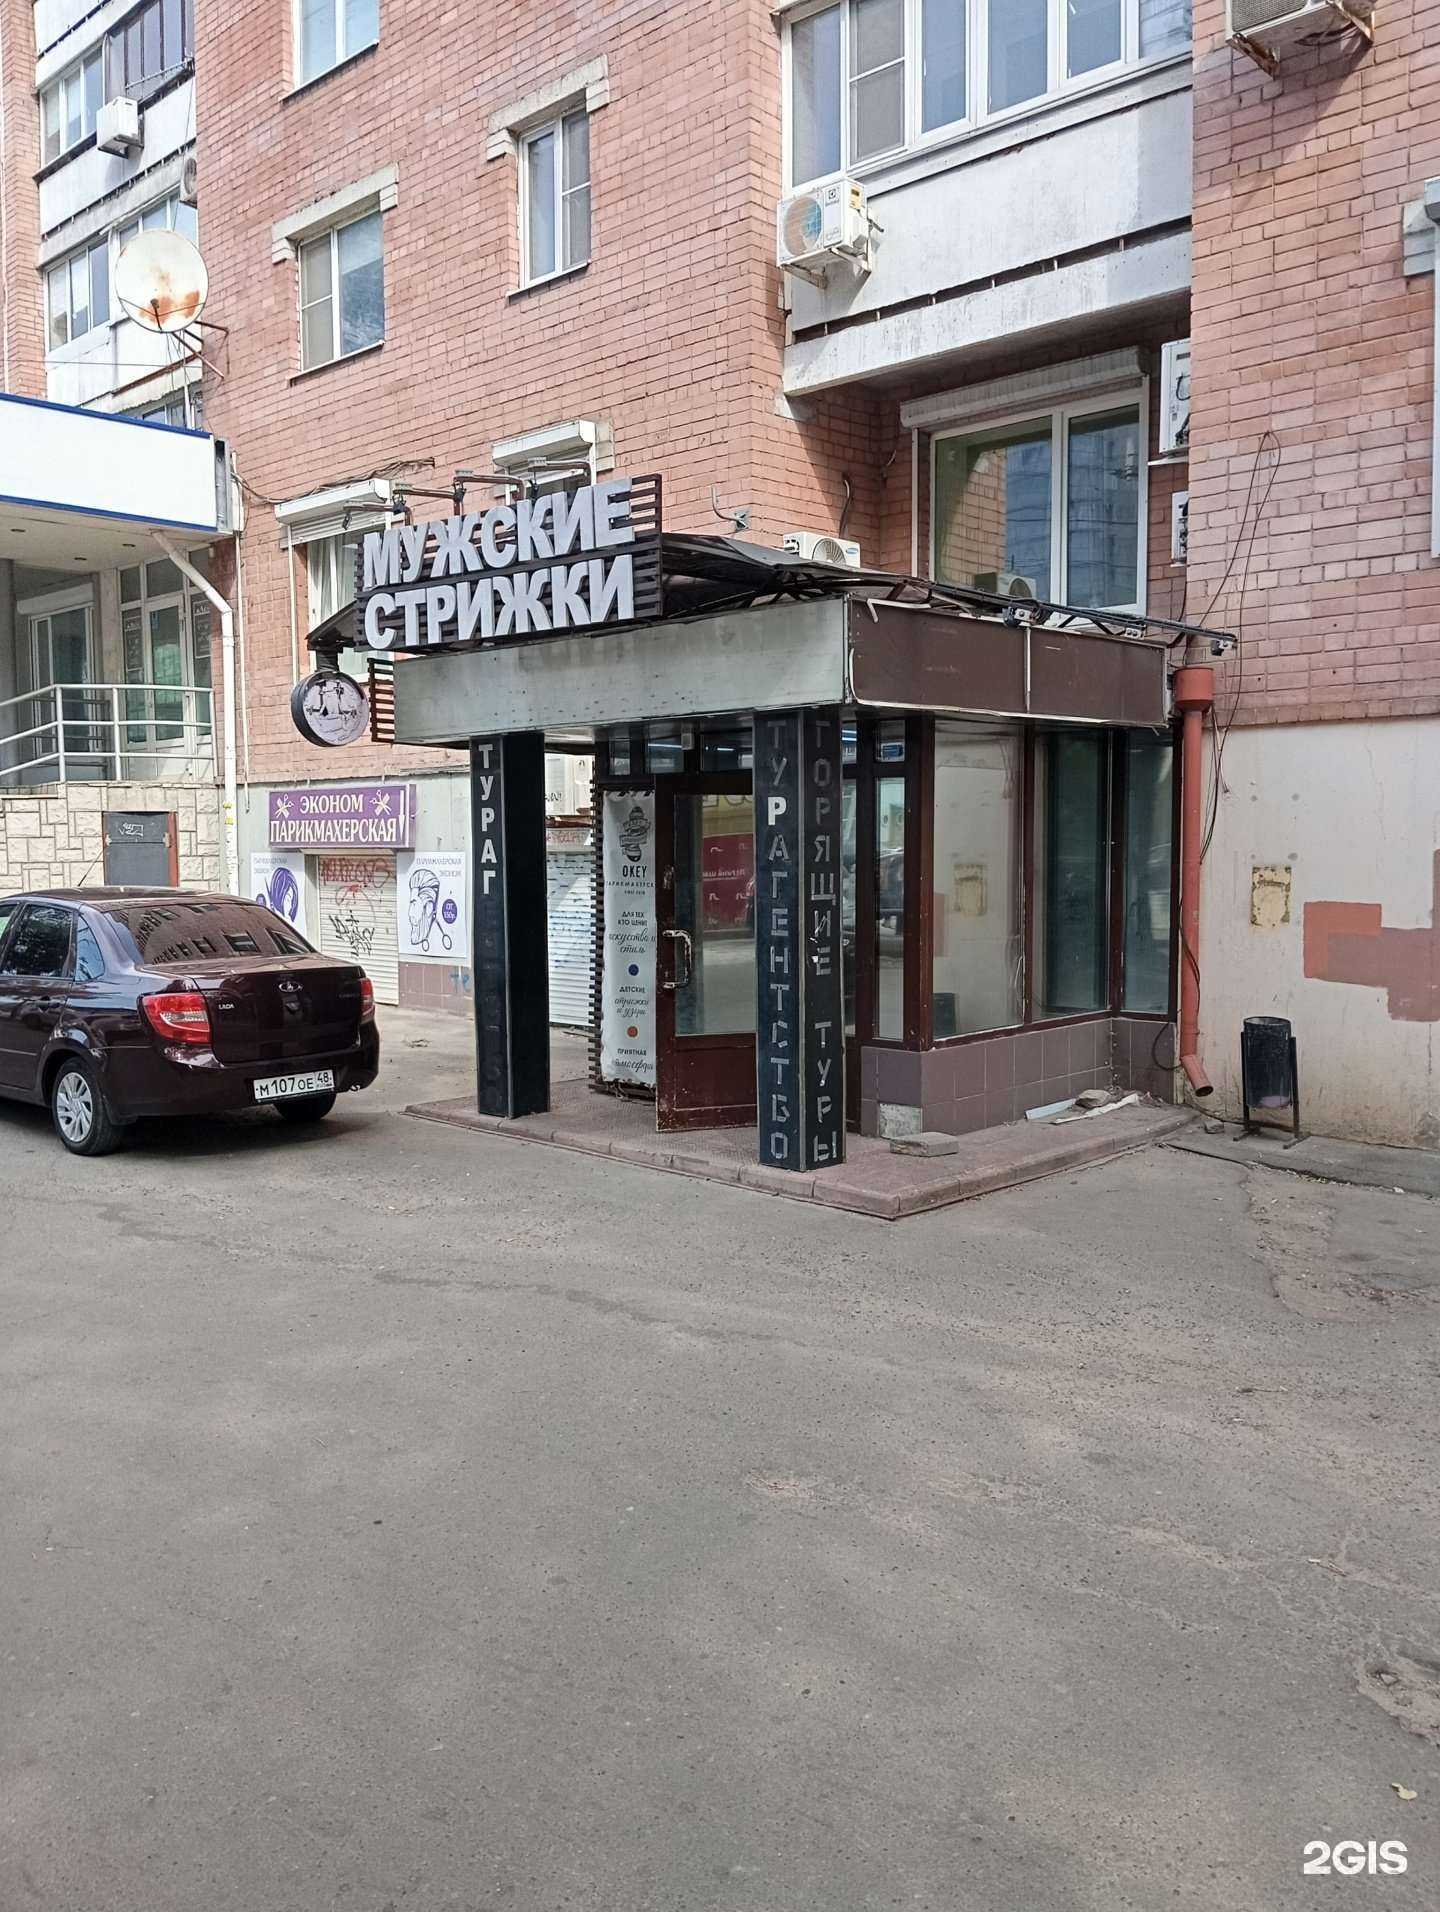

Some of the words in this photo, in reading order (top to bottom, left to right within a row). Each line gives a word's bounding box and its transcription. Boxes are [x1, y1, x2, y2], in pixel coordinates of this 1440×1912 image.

[363, 477, 635, 591] МУЖСКИЕ
[364, 554, 635, 650] СТРИЖКИ
[270, 818, 397, 843] ПАРИКМАХЕРСКАЯ
[299, 794, 364, 814] ЭКОНОМ
[622, 865, 647, 877] OKEY
[810, 721, 836, 976] ГОРЯЩИЕ
[617, 1048, 647, 1056] ПРИЯТНАЯ
[813, 1021, 838, 1161] ТУРЫ
